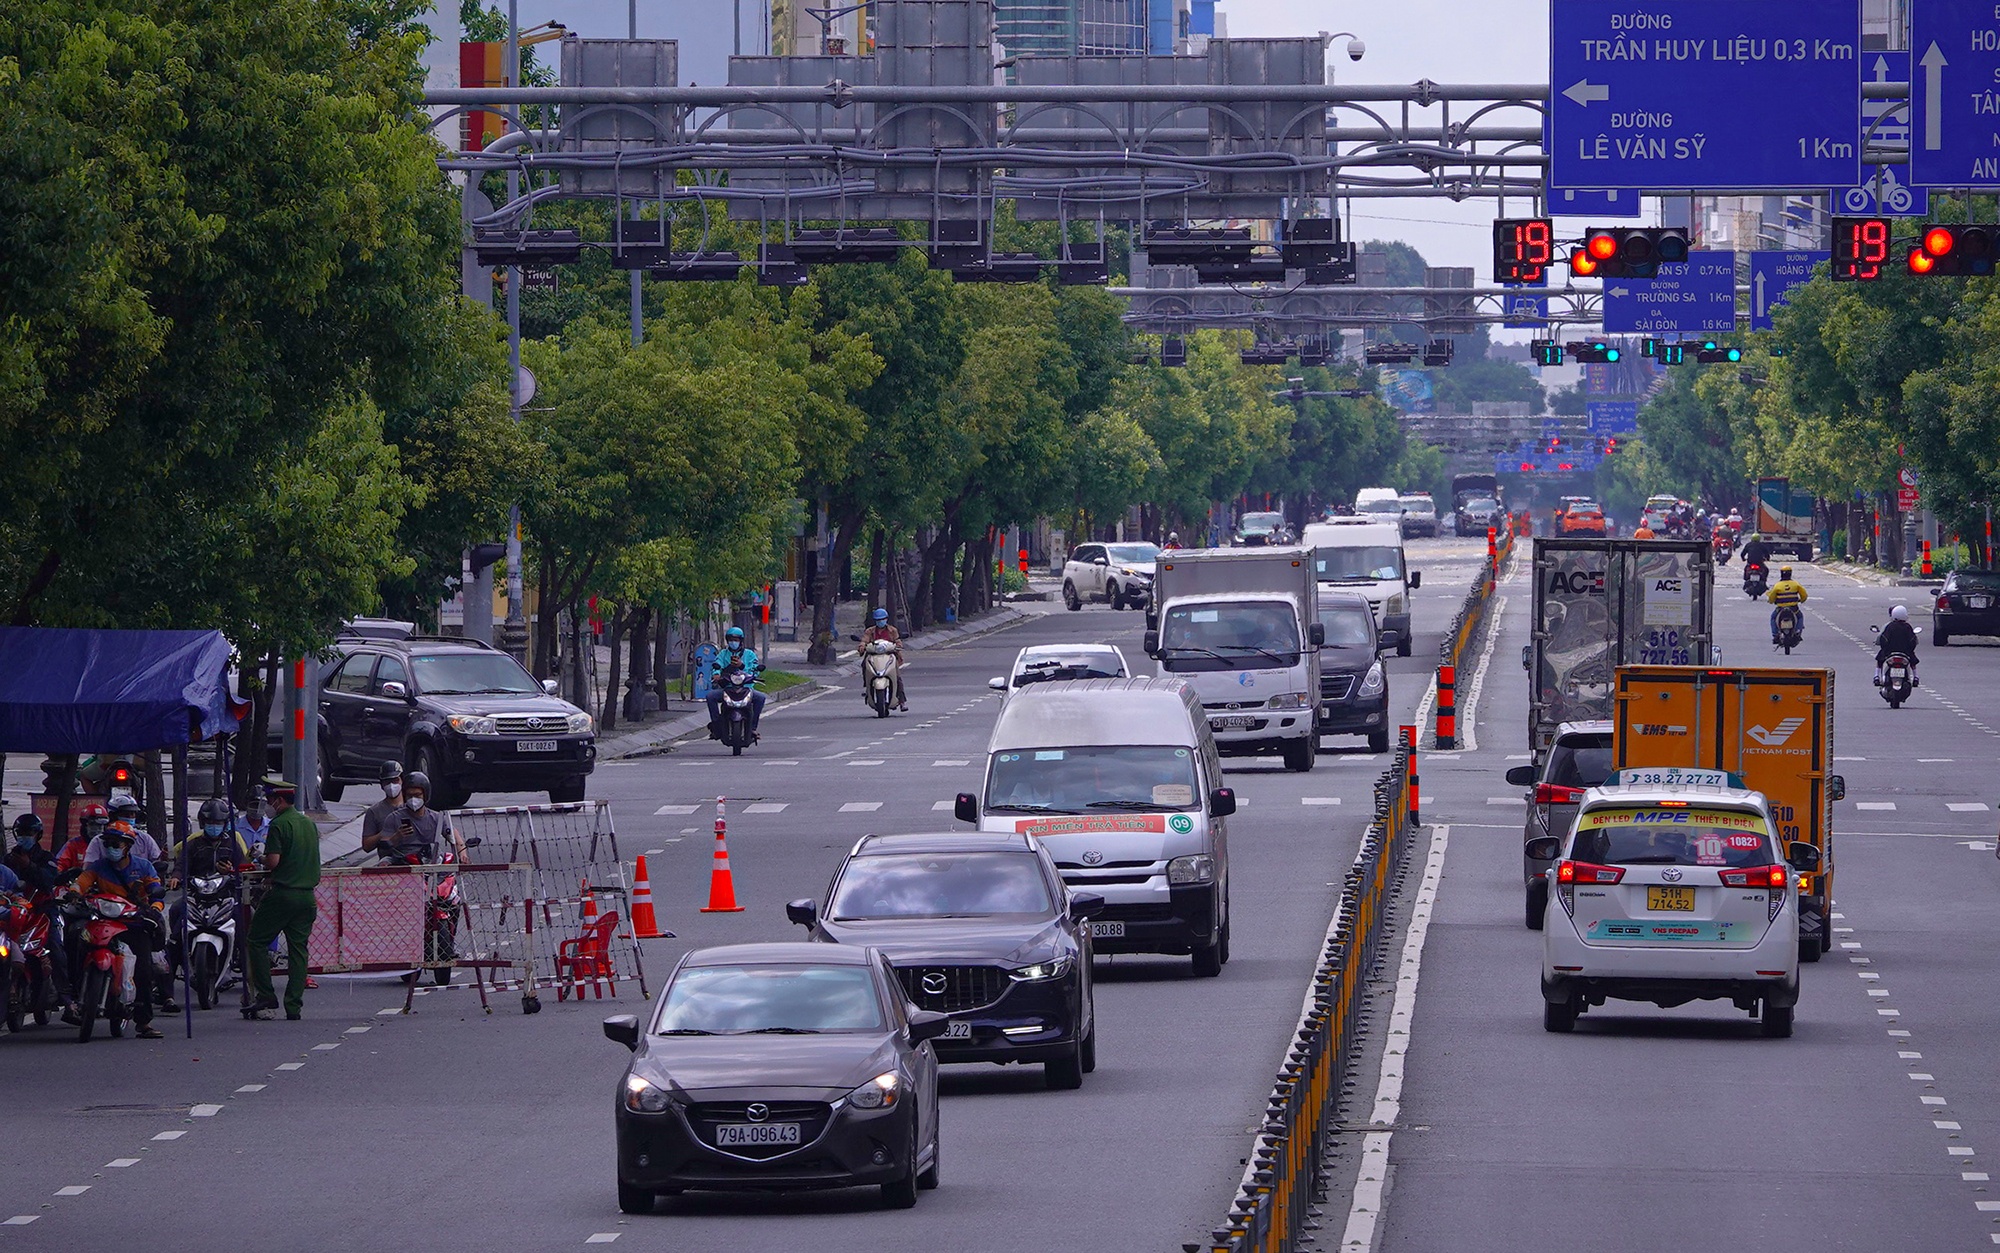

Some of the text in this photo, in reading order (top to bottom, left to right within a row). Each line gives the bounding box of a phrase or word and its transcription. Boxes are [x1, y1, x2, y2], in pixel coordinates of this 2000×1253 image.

[1611, 10, 1672, 30] ĐƯỜNG
[1971, 30, 2000, 51] HO
[1581, 31, 1852, 66] TRẦN HUY LIỆU 0,3 Km
[1611, 108, 1673, 128] ĐƯỜNG
[1579, 133, 1852, 160] LÊ VĂN SỸ 1 Km
[1516, 222, 1550, 263] 19
[1852, 221, 1886, 262] 19
[1716, 265, 1732, 275] Km
[1776, 263, 1804, 275] HOÀNG
[1651, 281, 1680, 290] ĐƯỜNG
[1636, 290, 1732, 302] TRƯỜNG SA 1 Km
[1635, 318, 1653, 330] SÀI
[1656, 318, 1678, 330] GÒN
[1716, 320, 1732, 330] Km
[1549, 572, 1604, 594] ACE
[1654, 580, 1682, 592] ACE
[1650, 631, 1678, 647] 51C
[1640, 650, 1689, 666] 727.56
[1643, 724, 1668, 736] EMS
[1644, 774, 1722, 785] 38.27 27 27
[1174, 818, 1188, 828] 09
[1613, 815, 1630, 823] LED
[1633, 812, 1690, 824] MPE
[1730, 836, 1757, 848] 10821
[1660, 888, 1682, 899] 51H
[1653, 900, 1689, 910] 714.52
[720, 1126, 797, 1144] 79A-096.43
